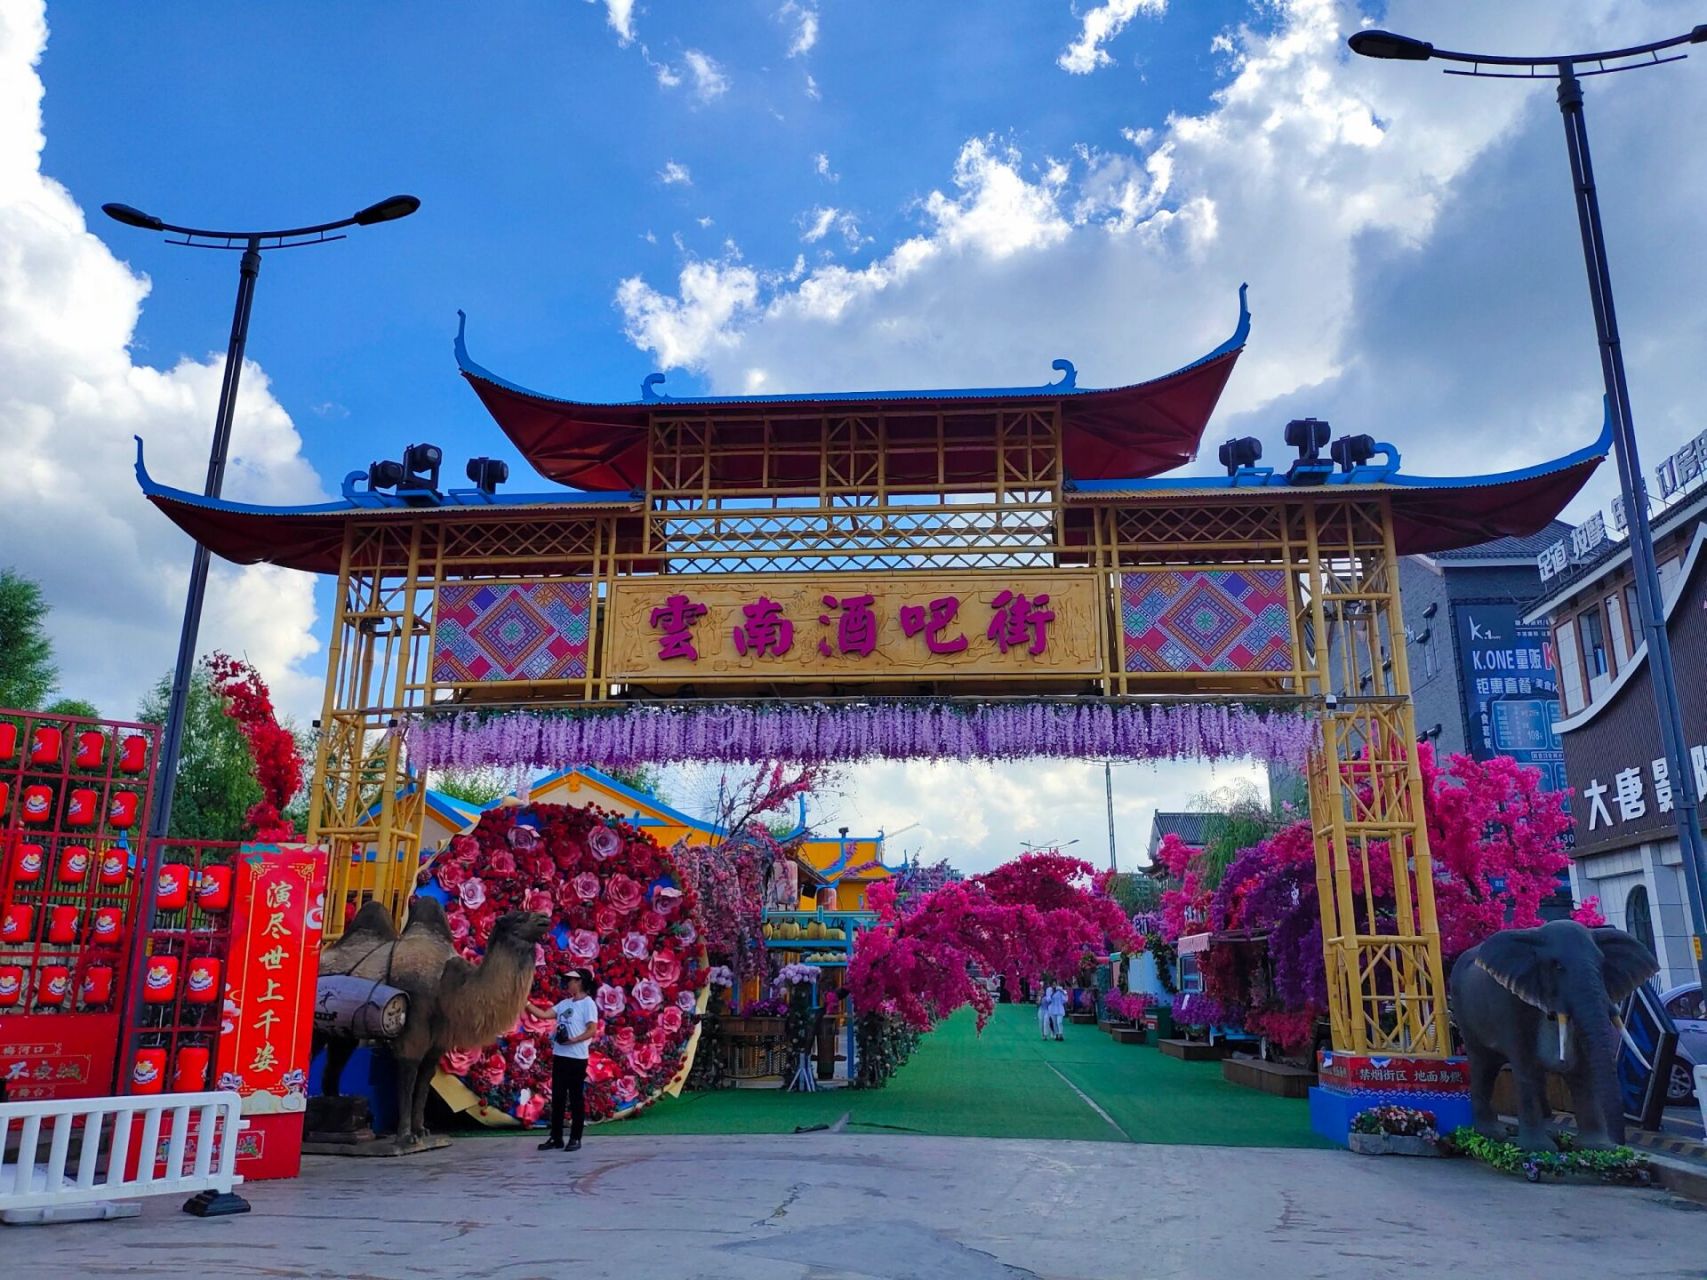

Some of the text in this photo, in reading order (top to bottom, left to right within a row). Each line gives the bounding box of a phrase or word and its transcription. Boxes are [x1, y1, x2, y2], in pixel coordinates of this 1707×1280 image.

[1537, 540, 1567, 582] 足道
[1570, 509, 1606, 559] 按摩
[650, 590, 1055, 661] 雲南酒吧街
[1476, 677, 1532, 695] 钜惠套餐
[248, 881, 295, 1074] 演尽世上千姿
[1359, 1068, 1408, 1082] 禁烟街区
